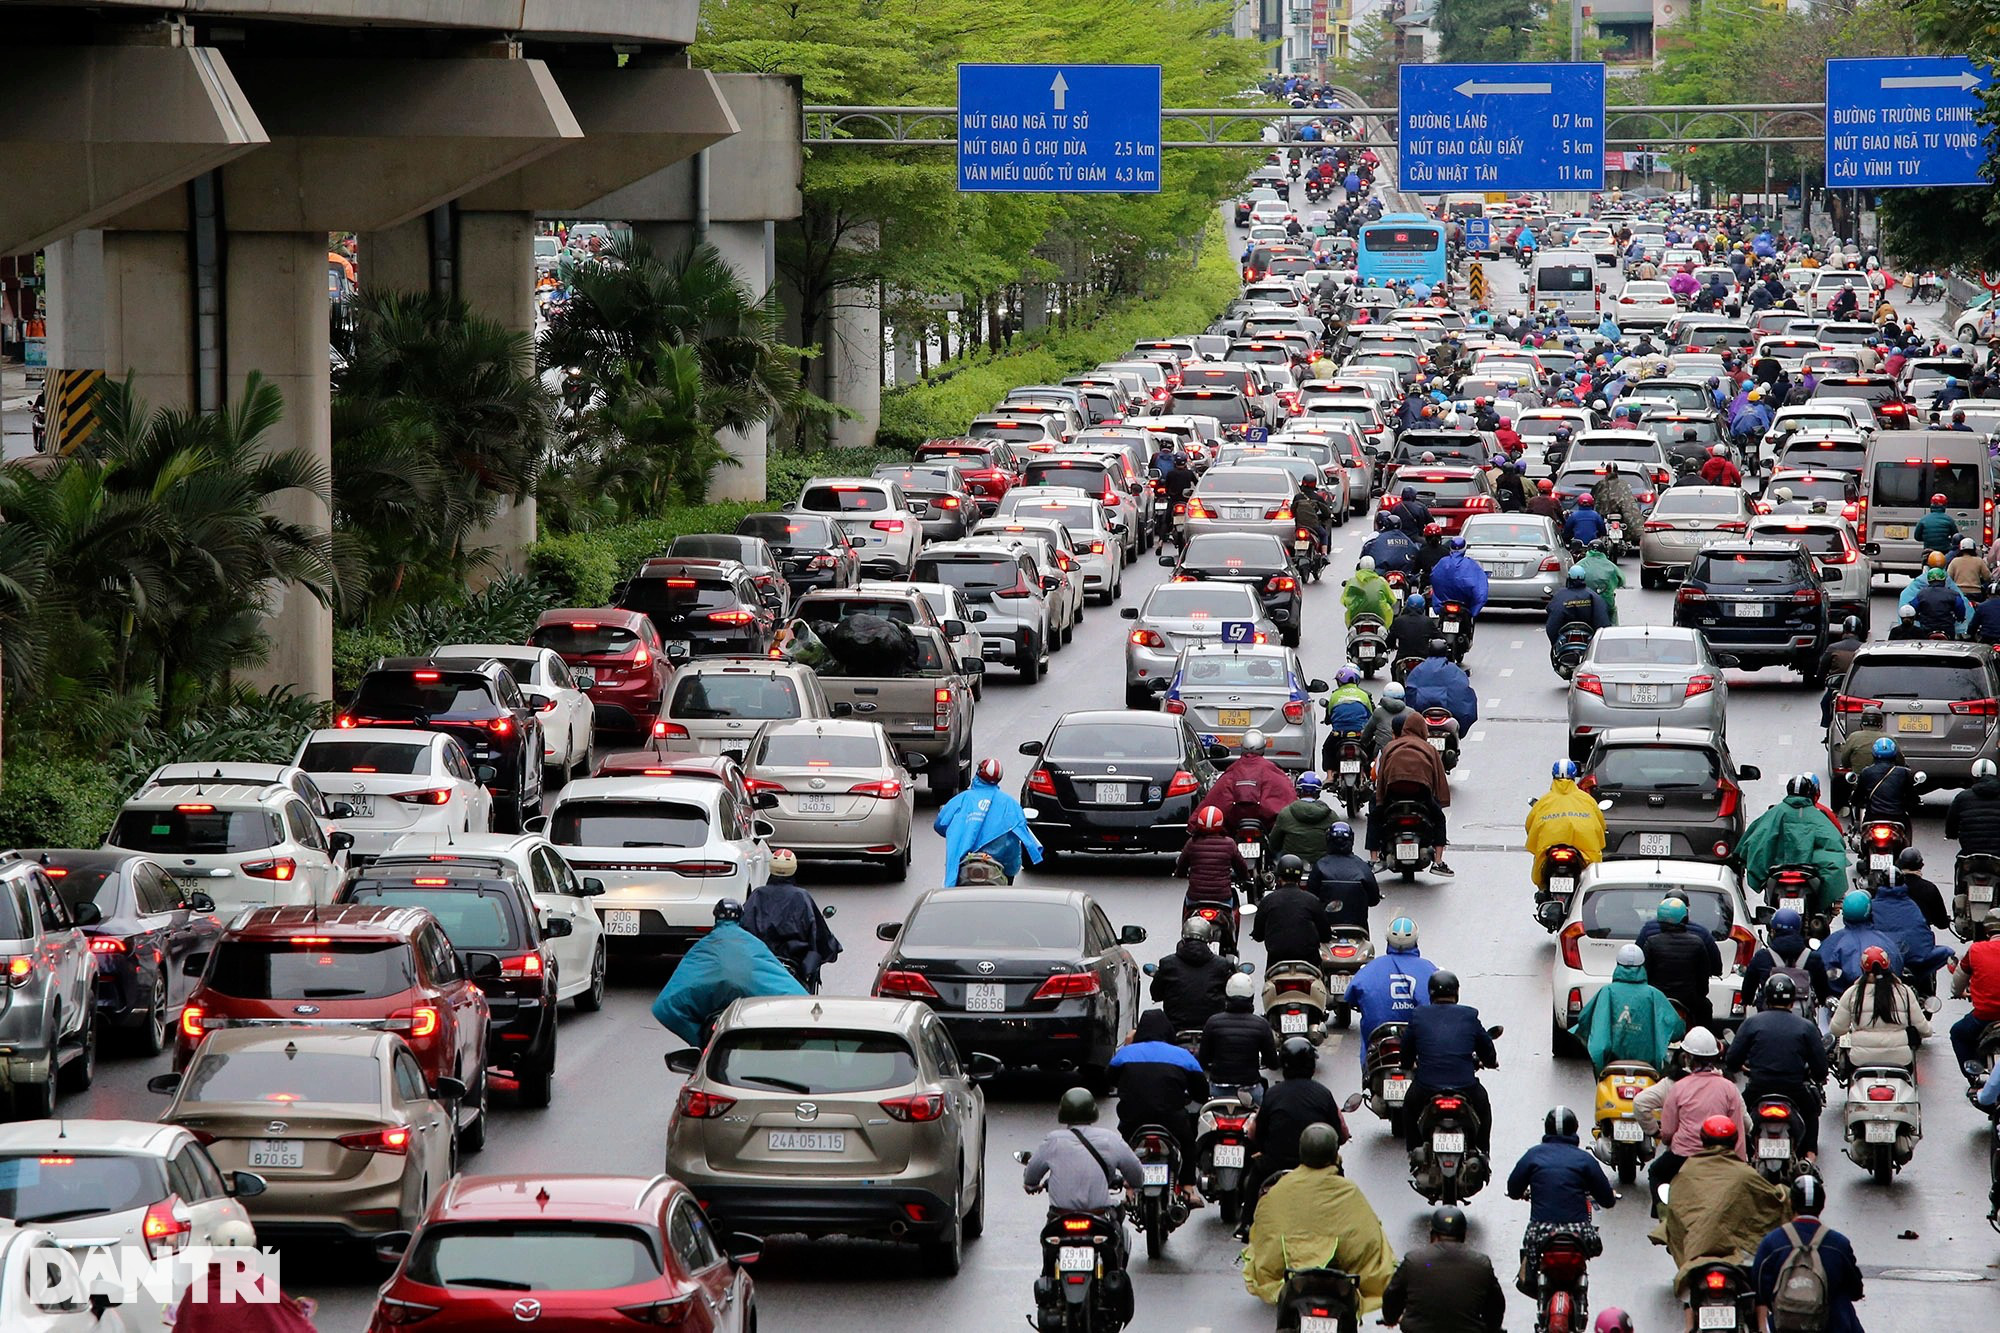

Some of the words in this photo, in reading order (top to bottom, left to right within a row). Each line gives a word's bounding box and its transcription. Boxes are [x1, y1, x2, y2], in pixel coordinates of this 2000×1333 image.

[1833, 104, 1876, 124] ĐƯỜNG
[1881, 103, 1931, 123] TRƯỜNG
[1935, 106, 1973, 122] CHINH
[964, 110, 987, 129] NÚT
[991, 114, 1018, 129] GIAO
[1023, 112, 1046, 129] NGÃ
[1052, 114, 1068, 129] TƯ
[1073, 111, 1089, 129] SỞ
[1409, 110, 1450, 129] ĐƯỜNG
[1456, 110, 1487, 129] LÁNG
[1574, 114, 1593, 128] km
[1410, 136, 1433, 154] NÚT
[1437, 140, 1464, 155] GIAO
[1469, 135, 1492, 155] CẦU
[1497, 135, 1524, 154] GIẤY
[1563, 140, 1570, 154] 5
[1574, 140, 1593, 154] km
[1834, 131, 1859, 150] NÚT
[1862, 135, 1890, 150] GIAO
[1894, 131, 1918, 149] NGÃ
[1923, 133, 1940, 149] TƯ
[1944, 133, 1977, 151] VỌNG
[964, 136, 987, 155] NÚT
[991, 140, 1018, 155] GIAO
[1022, 138, 1030, 155] Ô
[1035, 140, 1059, 158] CHỢ
[1063, 136, 1087, 155] DỪA
[1136, 141, 1155, 155] km
[965, 162, 987, 180] VĂN
[991, 161, 1019, 181] MIẾU
[1023, 162, 1054, 181] QUỐC
[1058, 162, 1073, 180] TỬ
[1077, 163, 1106, 181] GIÁM
[1136, 167, 1155, 181] km
[1410, 161, 1432, 181] CẦU
[1437, 164, 1469, 183] NHẬT
[1475, 164, 1498, 180] TÂN
[1558, 166, 1570, 179] 11
[1574, 166, 1593, 180] km
[1834, 157, 1858, 177] CẦU
[1863, 158, 1892, 176] VĨNH
[1229, 624, 1247, 641] G7
[575, 667, 589, 675] 30A
[727, 739, 743, 748] 30E
[1103, 784, 1120, 793] 29A
[350, 795, 367, 805] 30A
[1647, 835, 1663, 844] 30F
[1640, 845, 1668, 854] 969.31
[180, 878, 198, 887] 30G
[613, 911, 632, 922] 30G
[607, 922, 640, 933] 175.66
[1391, 1001, 1415, 1010] Abbo
[1386, 1090, 1406, 1098] 168.7
[265, 1141, 288, 1152] 30G
[772, 1135, 842, 1149] 24A-051.15
[254, 1153, 297, 1165] 870.65
[1215, 1155, 1242, 1166] 530.09
[1061, 1259, 1092, 1269] 652.00
